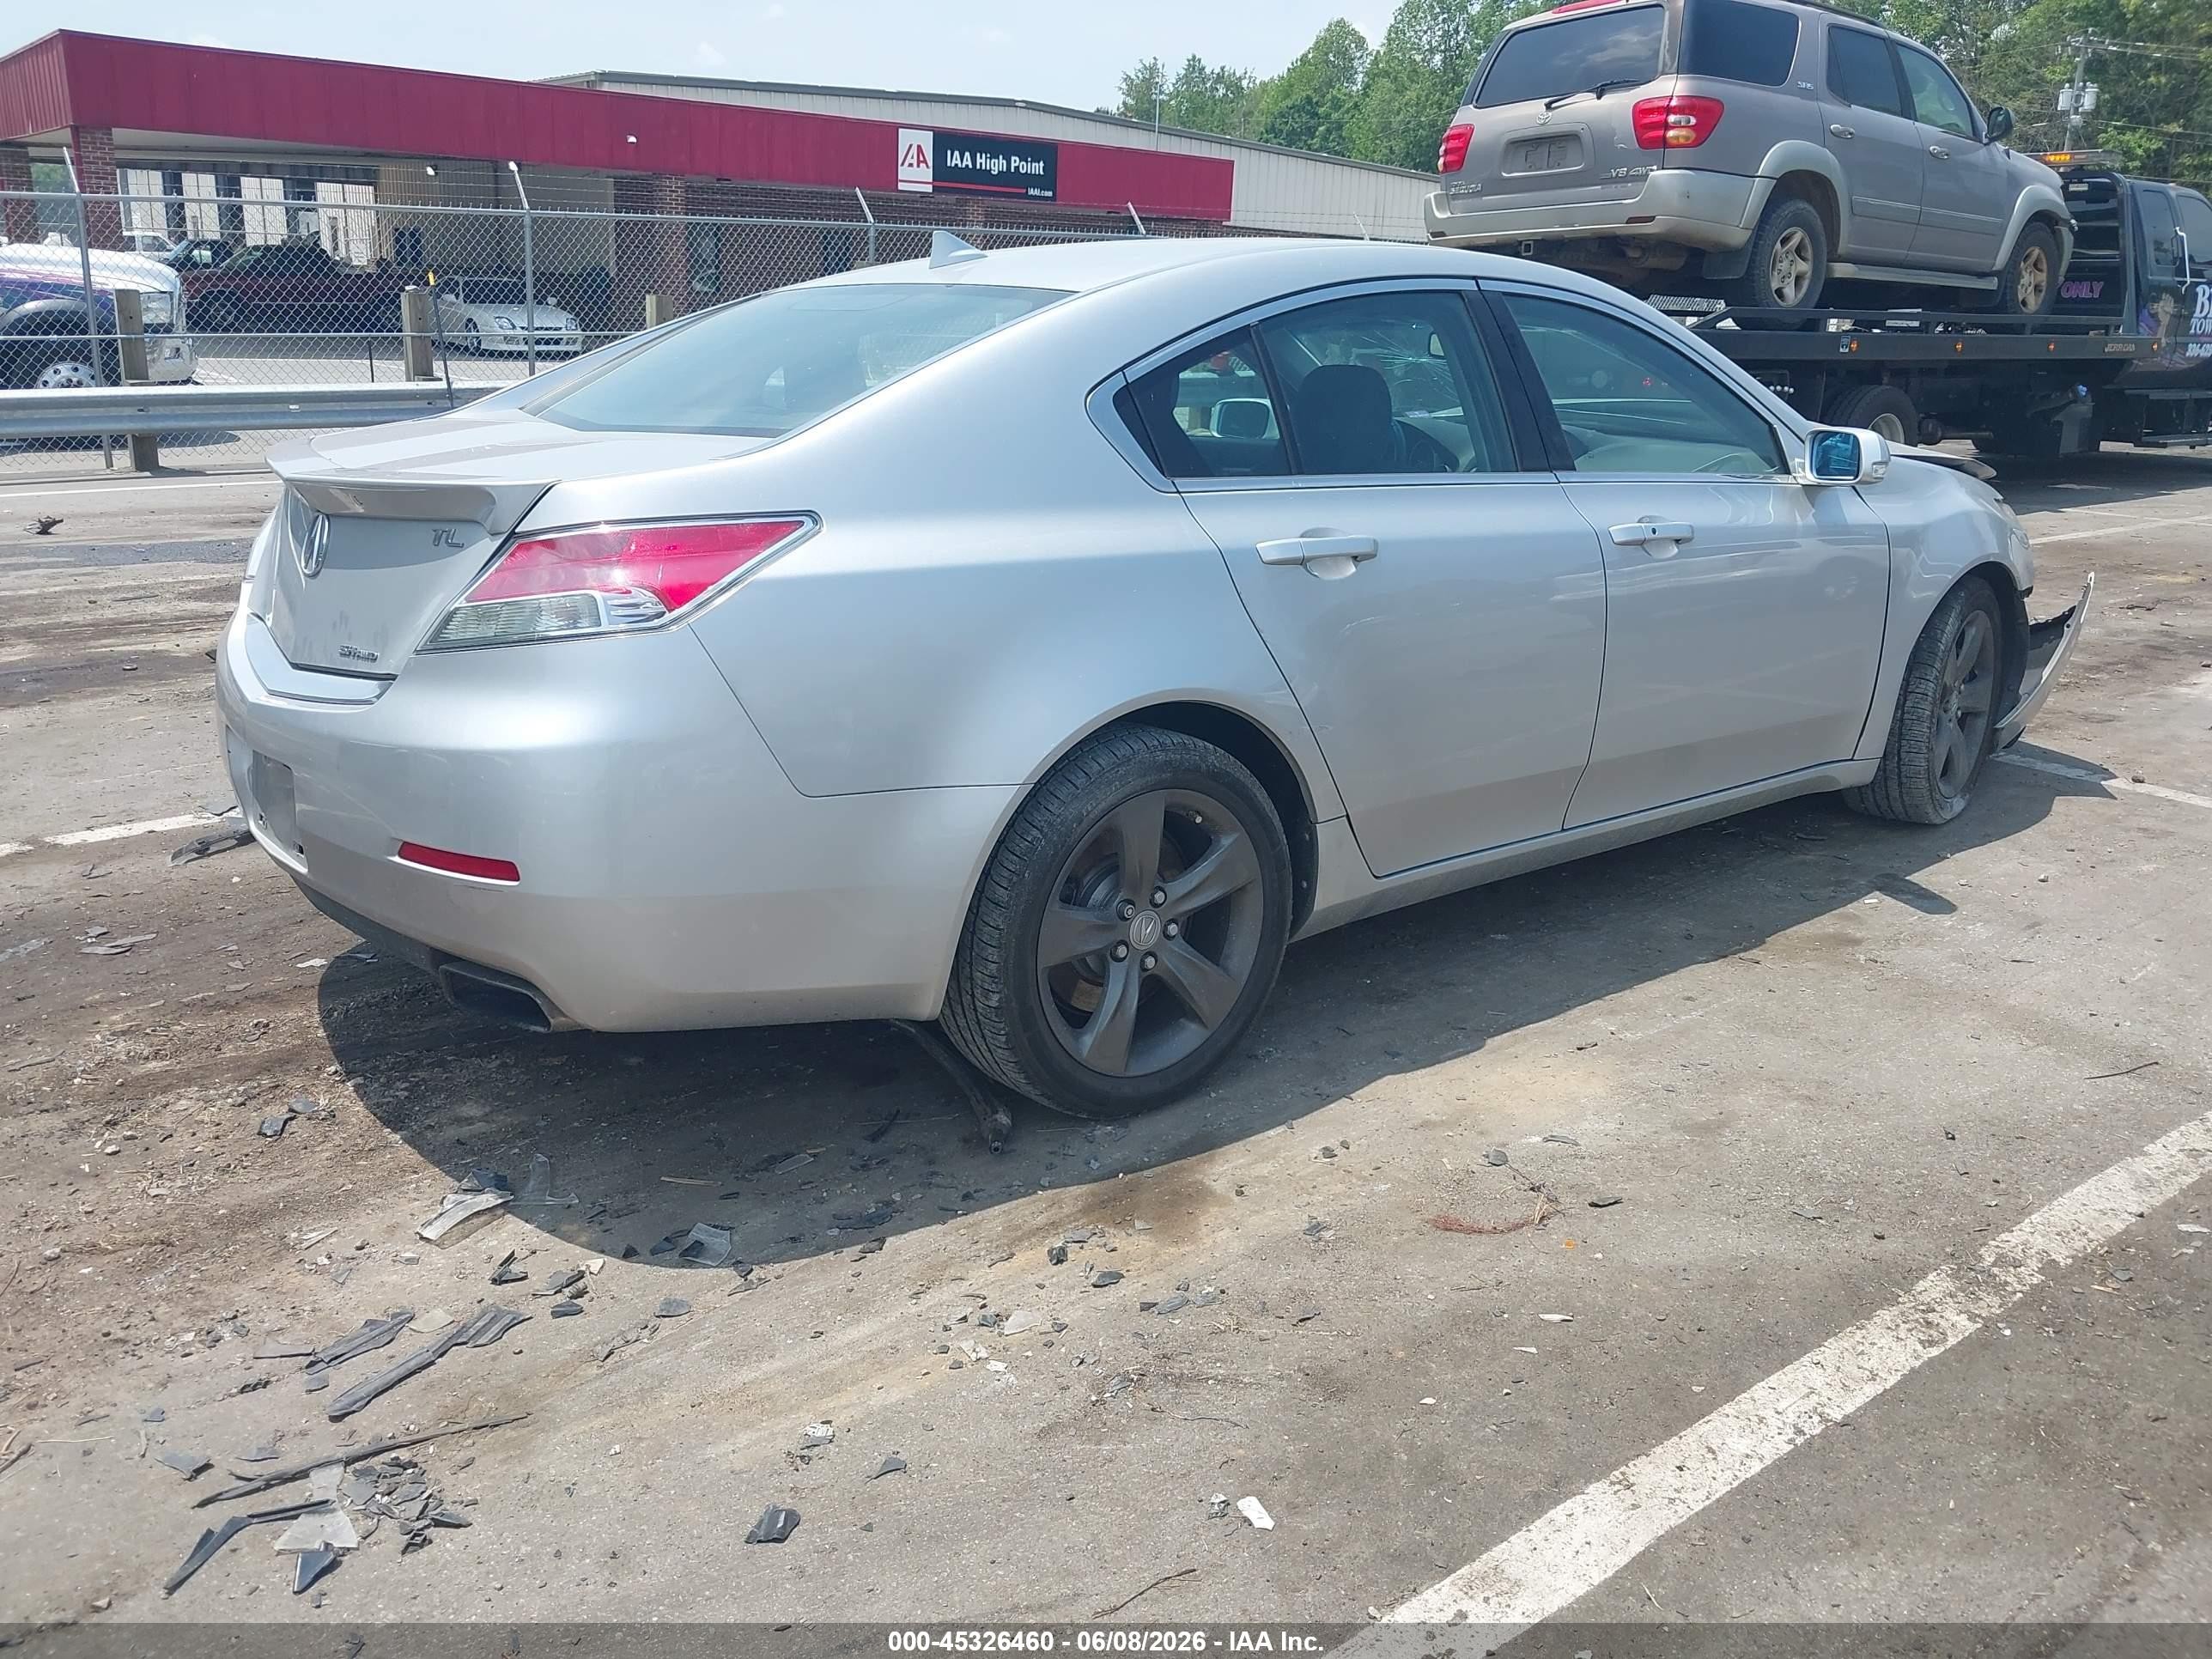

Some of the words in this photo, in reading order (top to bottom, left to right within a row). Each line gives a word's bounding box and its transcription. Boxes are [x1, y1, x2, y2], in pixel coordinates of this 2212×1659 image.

[946, 149, 973, 169] IAA
[976, 153, 1006, 175] High
[1011, 155, 1045, 175] Point
[1610, 167, 1628, 178] V8
[2061, 281, 2104, 299] ONLY
[2192, 284, 2212, 319] B
[431, 528, 465, 548] TL
